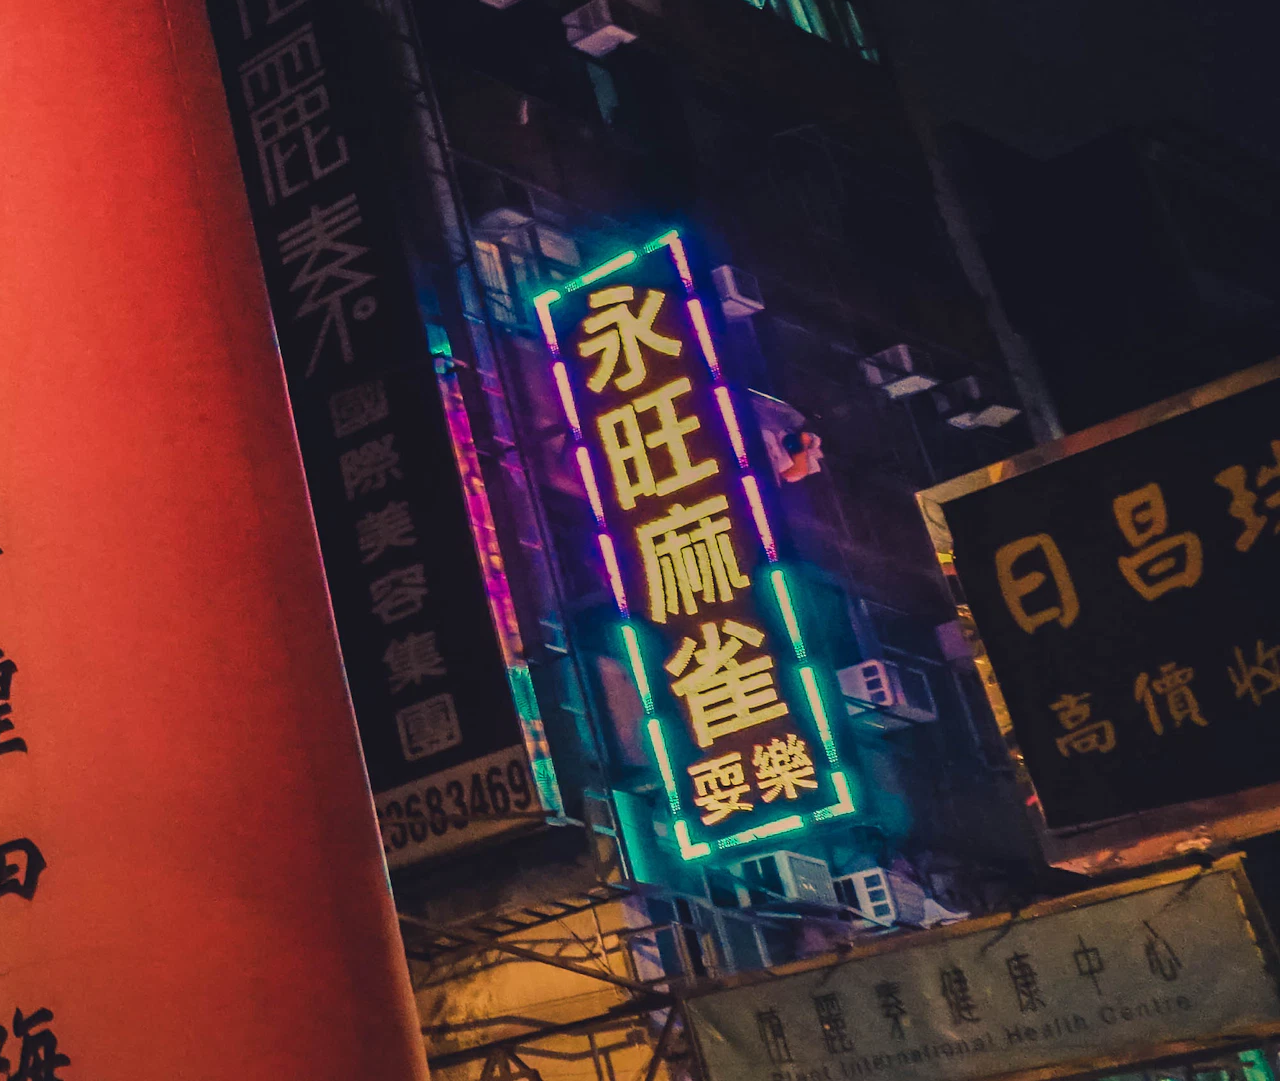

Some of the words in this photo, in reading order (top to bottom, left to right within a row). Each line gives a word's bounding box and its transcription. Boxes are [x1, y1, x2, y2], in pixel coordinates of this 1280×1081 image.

[577, 283, 788, 749] 永旺麻雀
[377, 759, 532, 854] 3683469
[686, 731, 819, 826] 耍樂
